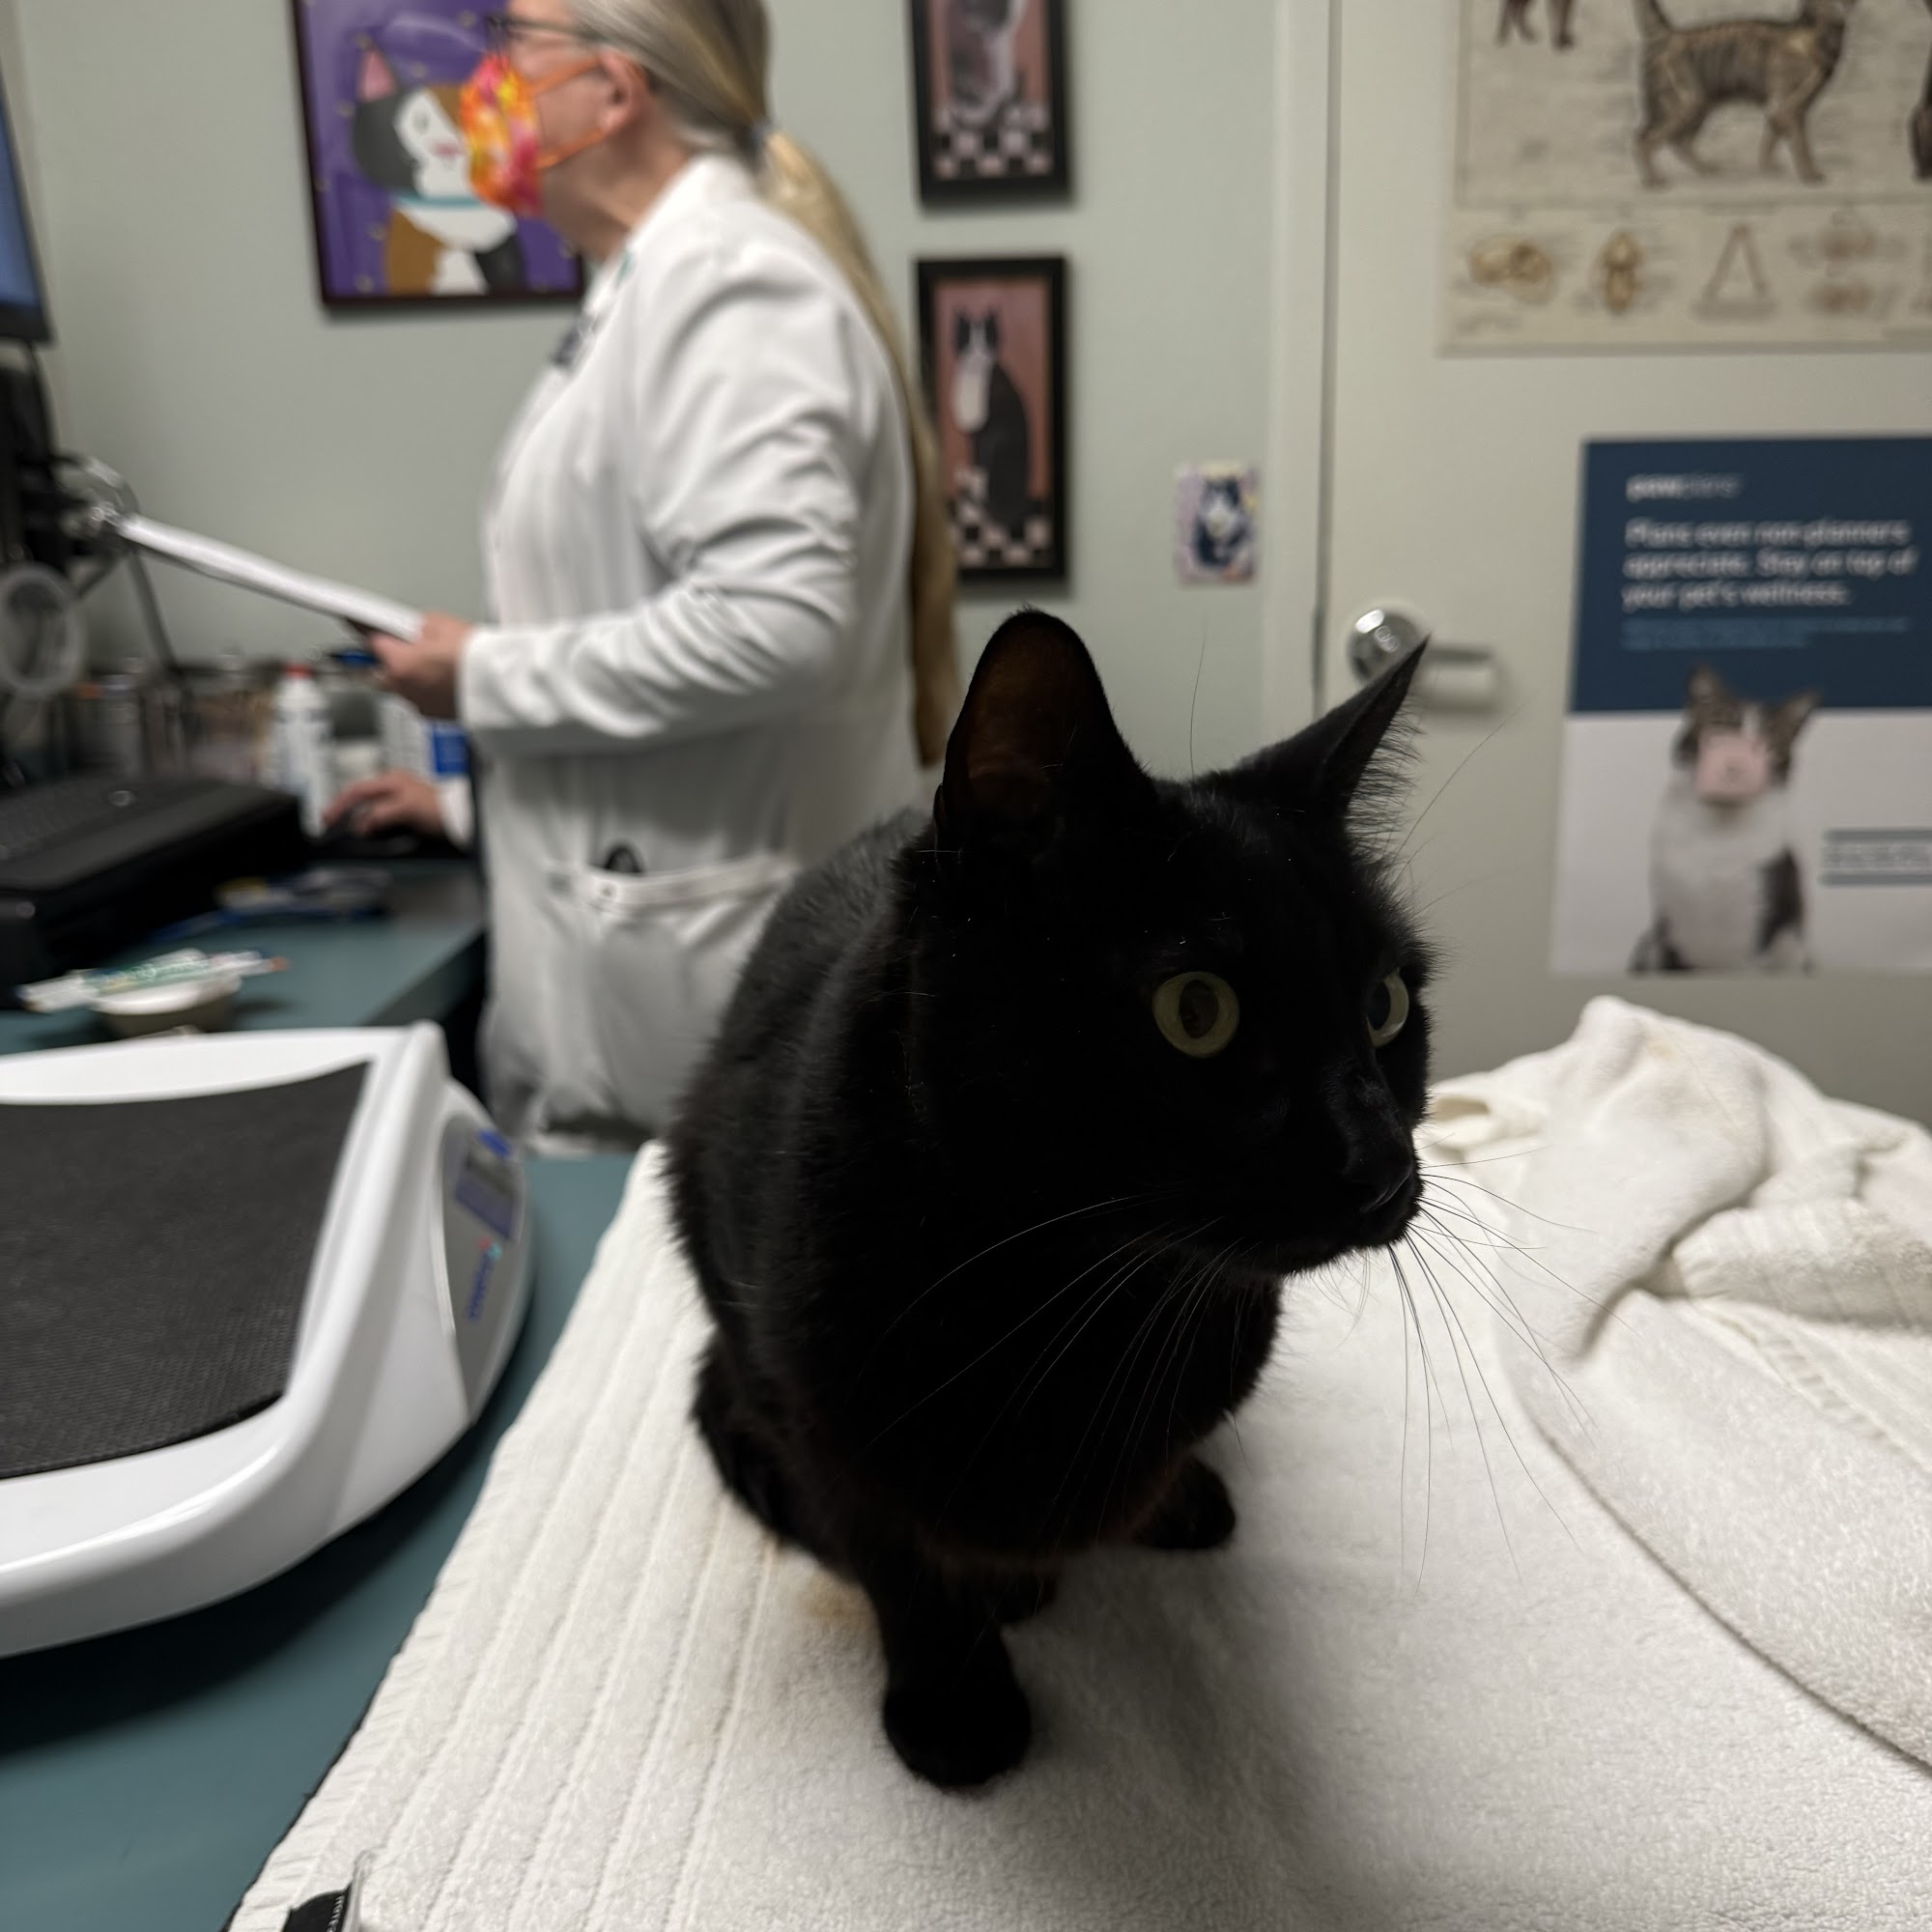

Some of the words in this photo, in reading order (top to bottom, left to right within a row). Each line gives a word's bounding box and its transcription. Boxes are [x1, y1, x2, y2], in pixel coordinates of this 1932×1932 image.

[1695, 523, 1750, 548] even
[1756, 549, 1807, 579] Stay
[1811, 551, 1844, 576] on
[1846, 551, 1887, 579] top
[1889, 546, 1918, 575] of
[1622, 582, 1677, 611] your
